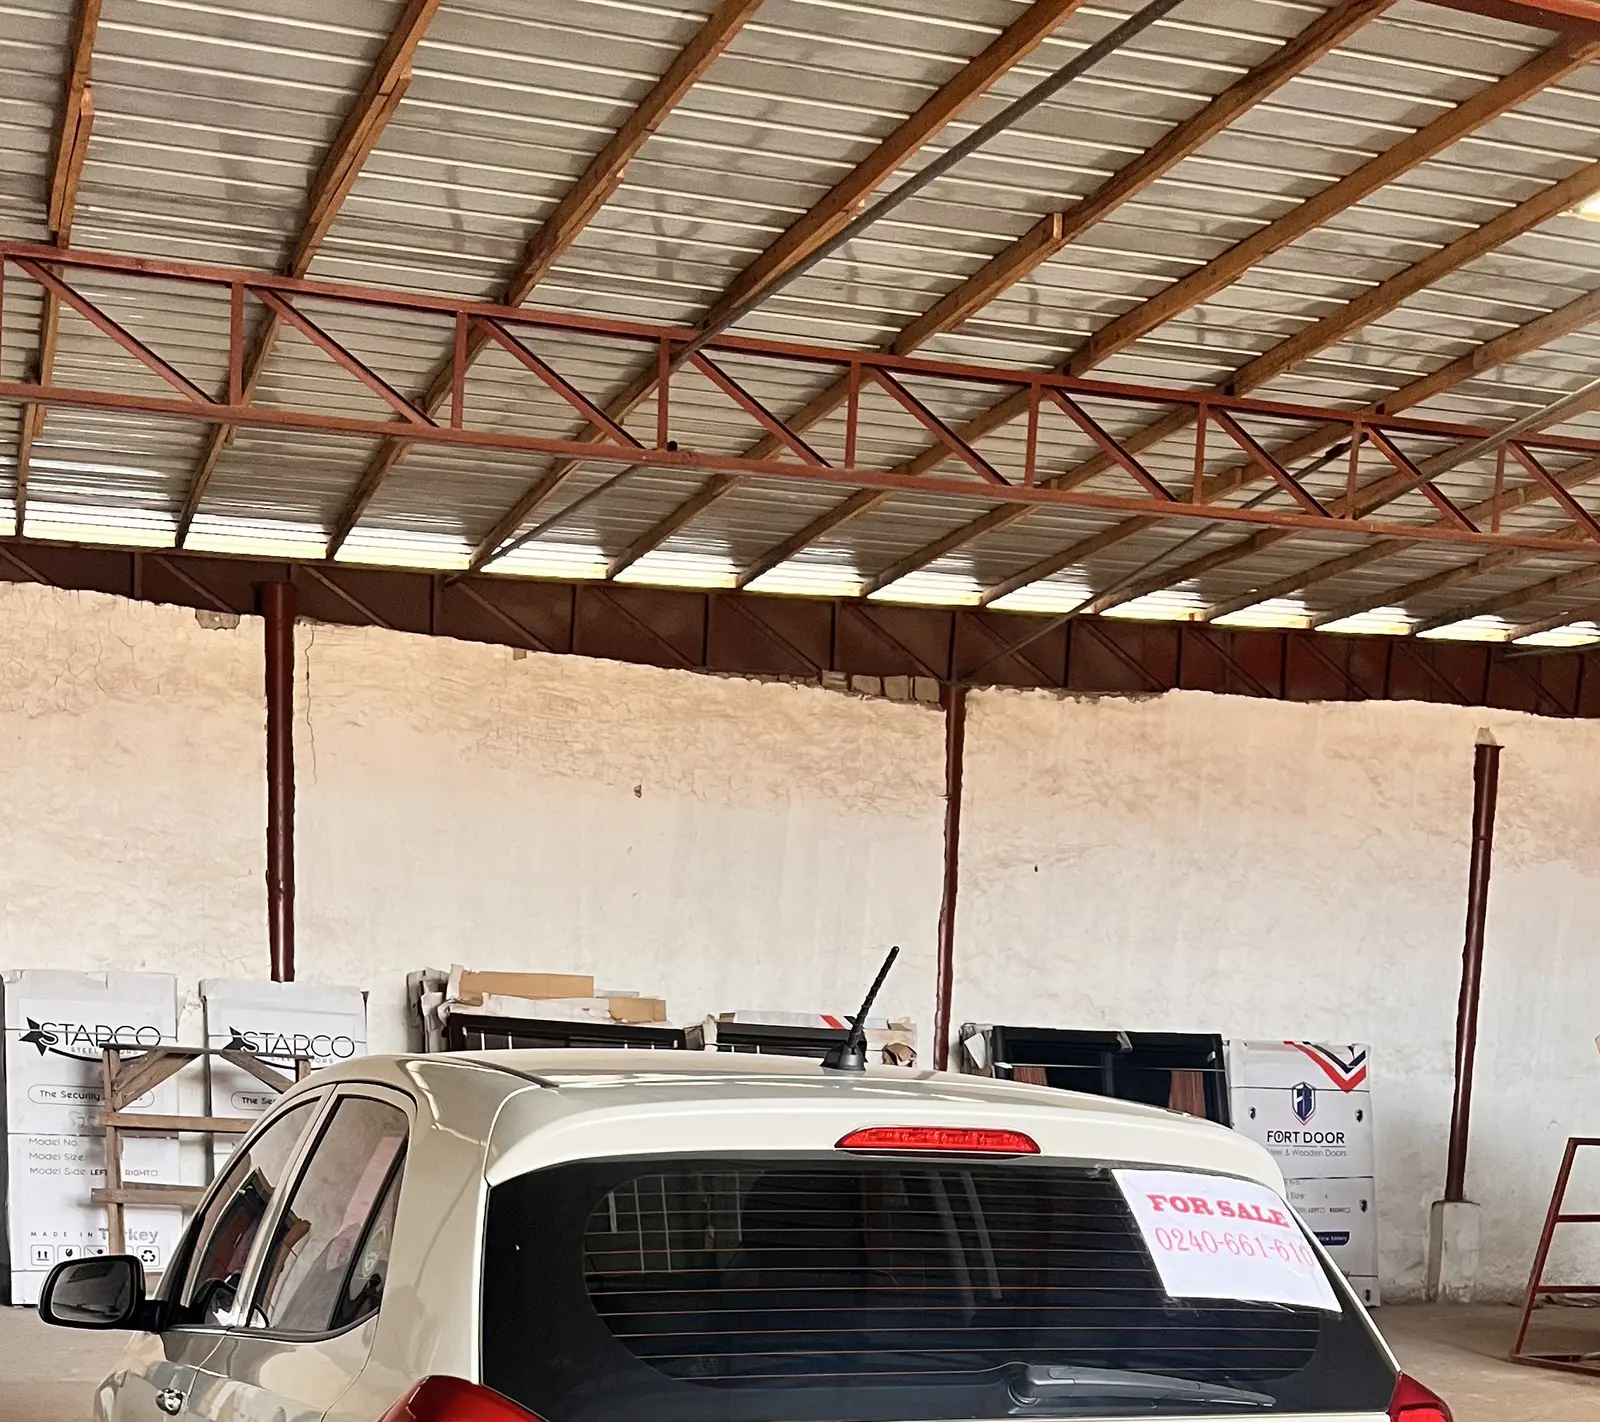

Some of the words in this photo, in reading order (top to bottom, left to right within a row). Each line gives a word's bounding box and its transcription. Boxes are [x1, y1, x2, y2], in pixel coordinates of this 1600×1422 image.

[40, 1022, 162, 1047] STARCO
[243, 1031, 355, 1058] STARCO
[40, 1090, 57, 1098] The
[61, 1090, 100, 1102] Security
[241, 1096, 258, 1104] The
[28, 1138, 60, 1146] Model
[1267, 1130, 1300, 1143] FORT
[1303, 1132, 1345, 1144] DOOR
[29, 1152, 60, 1160] Model
[64, 1153, 84, 1161] Size
[1325, 1149, 1346, 1157] Doors
[30, 1167, 61, 1176] Model
[1146, 1194, 1215, 1216] FOR
[1216, 1200, 1291, 1229] SALE
[98, 1227, 159, 1244] Tkey
